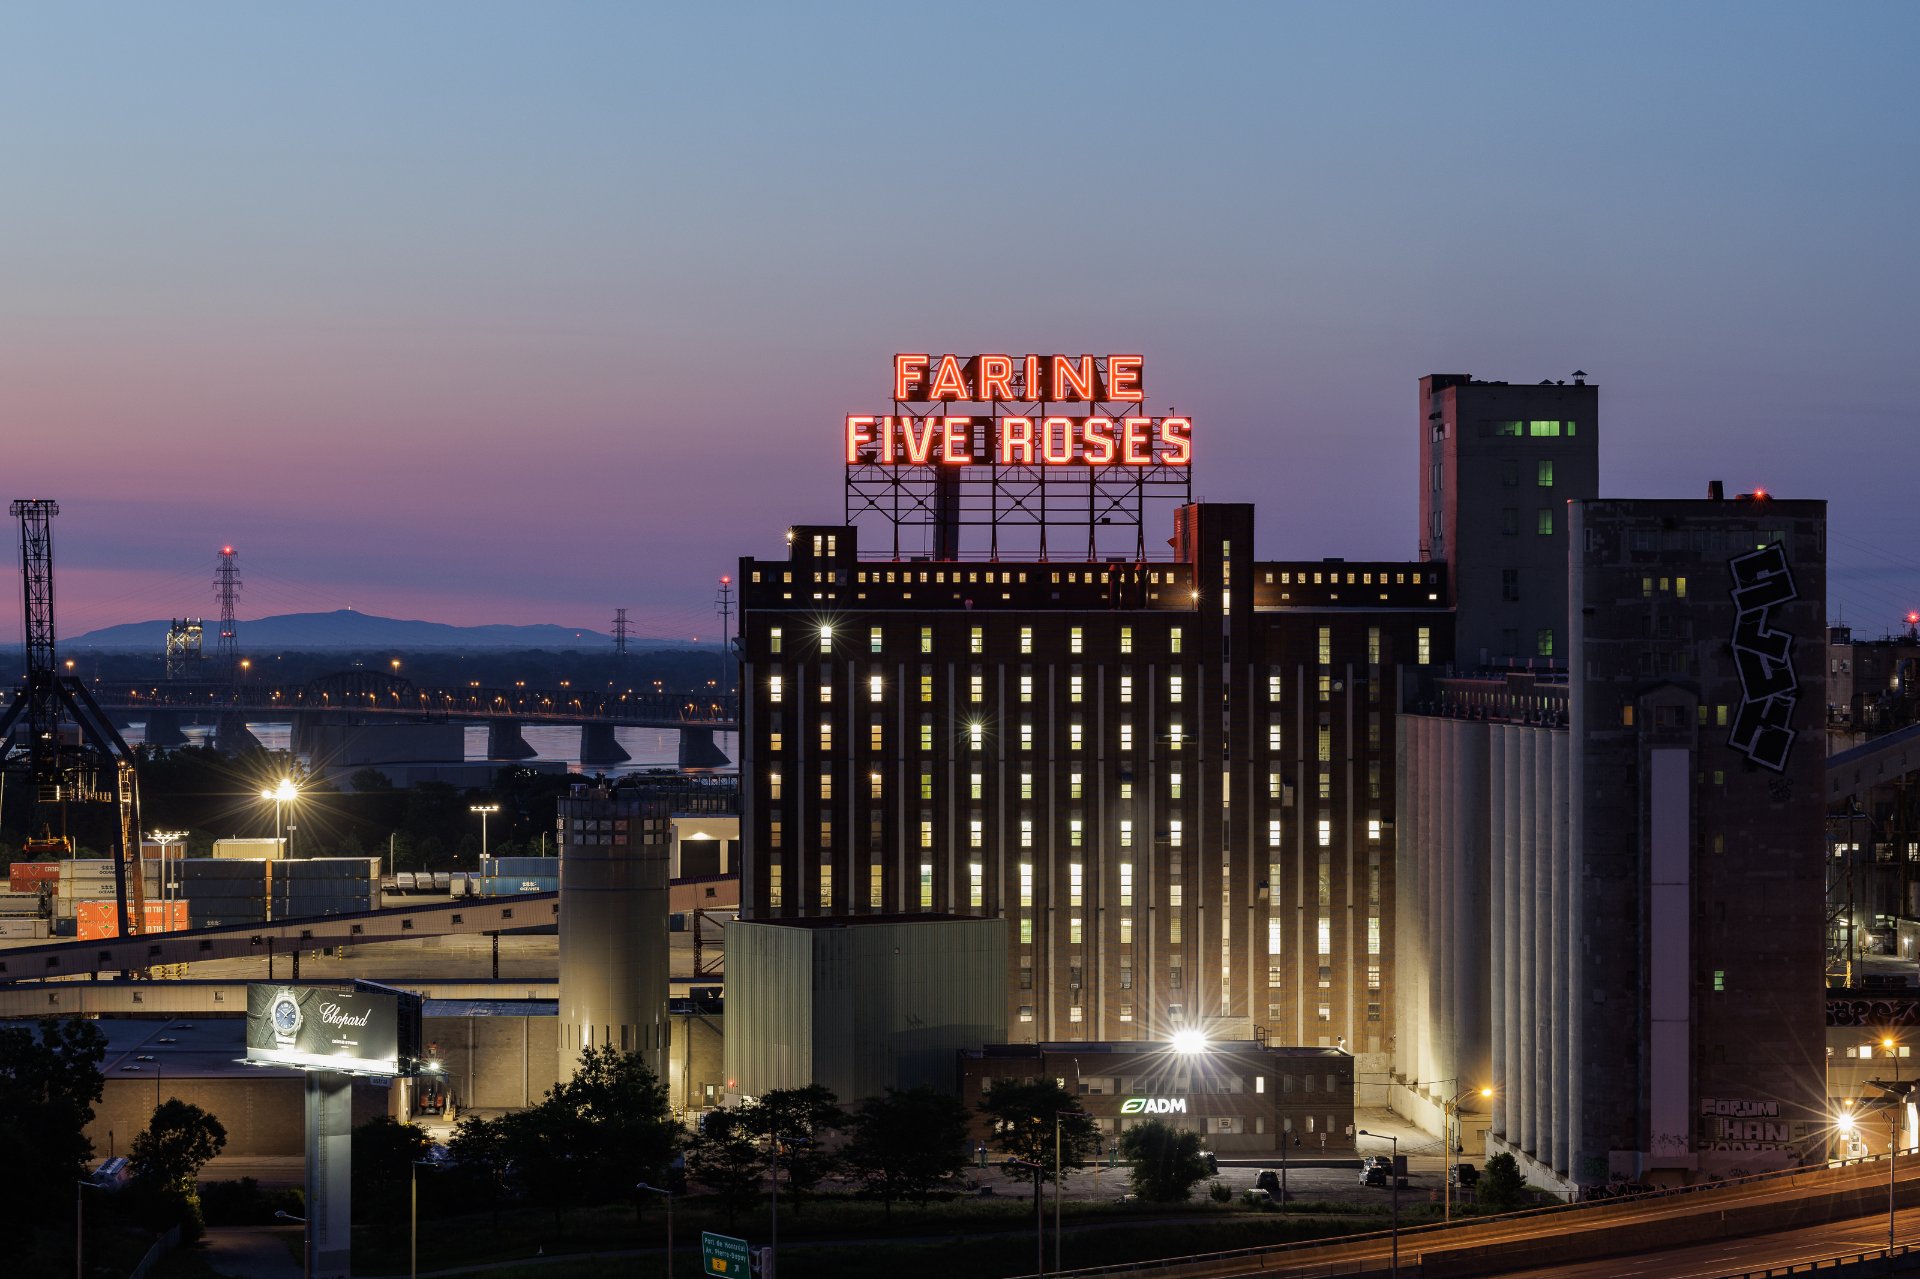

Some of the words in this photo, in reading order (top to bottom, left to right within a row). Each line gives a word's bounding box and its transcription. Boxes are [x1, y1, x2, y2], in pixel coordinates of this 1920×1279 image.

[895, 354, 1143, 400] FARINE
[846, 416, 971, 464] FIVE
[1001, 416, 1192, 464] ROSES
[319, 1002, 372, 1029] Chopard
[1144, 1098, 1187, 1113] ADM
[1700, 1097, 1779, 1117] FORUM
[704, 1237, 715, 1246] Port
